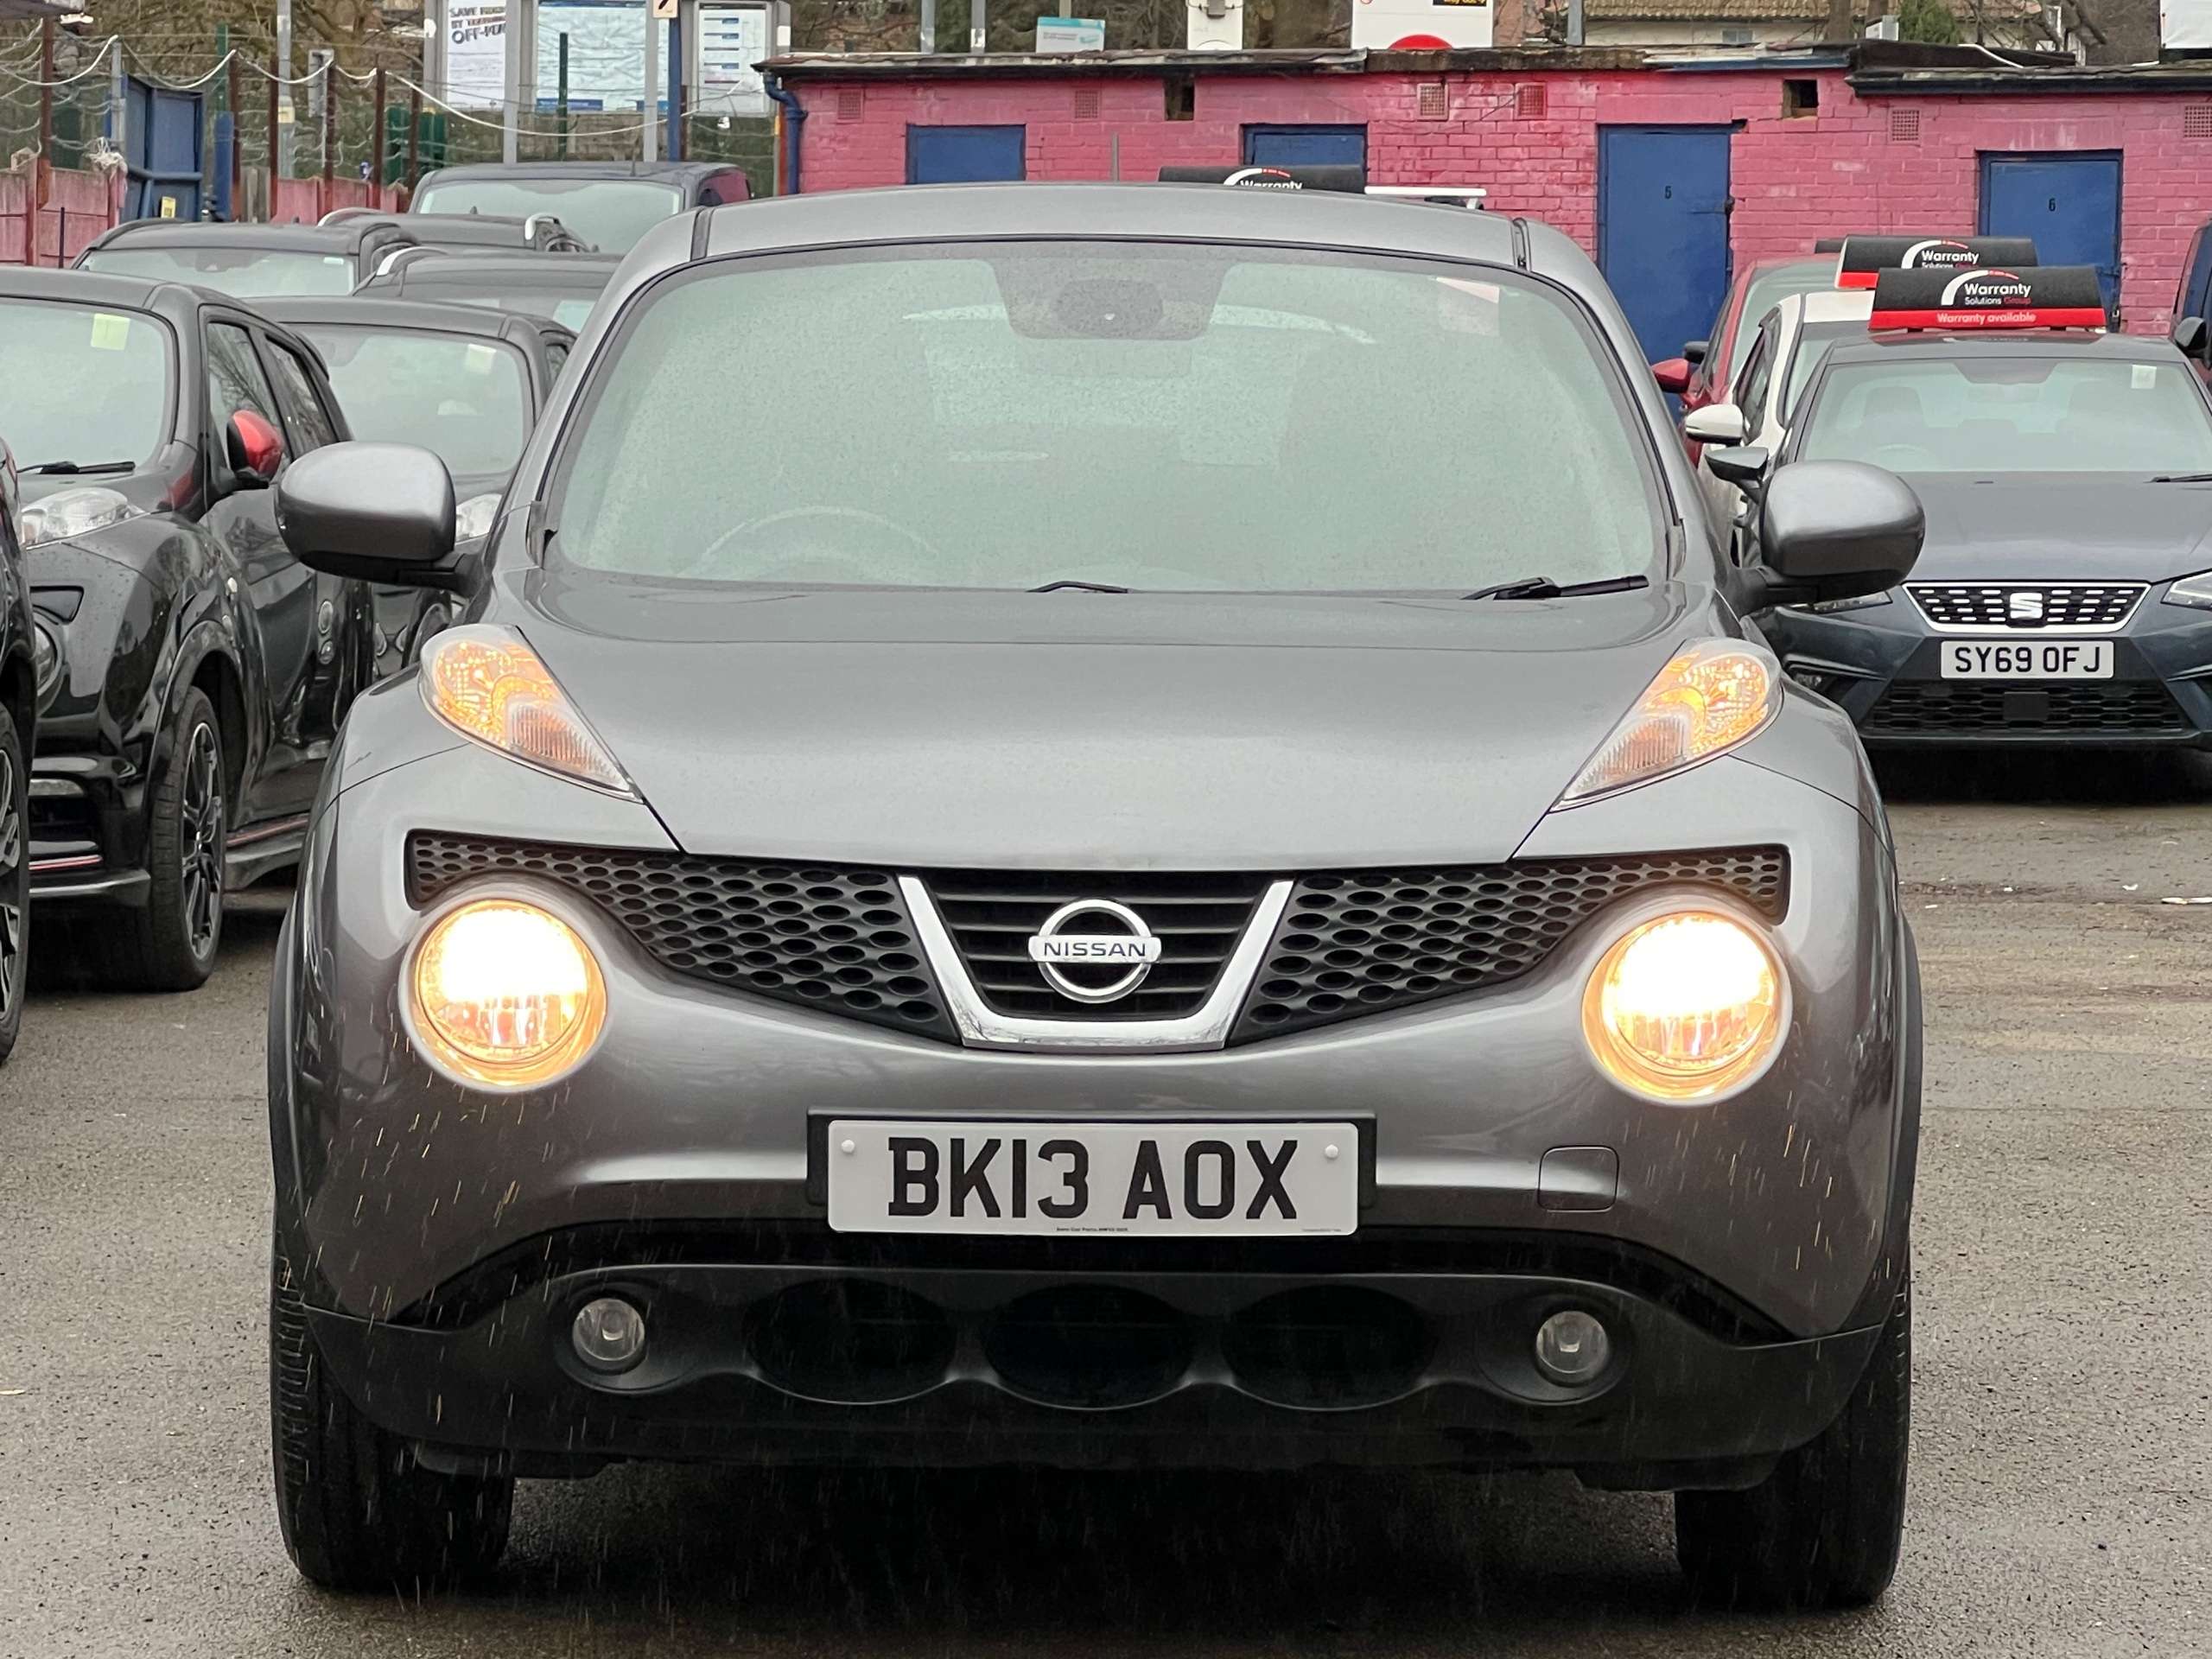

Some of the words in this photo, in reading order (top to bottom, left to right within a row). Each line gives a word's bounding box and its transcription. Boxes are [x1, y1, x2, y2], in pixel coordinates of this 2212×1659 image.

[1665, 185, 1672, 200] 5
[2049, 198, 2056, 212] 6
[1922, 250, 1979, 264] Warranty
[1964, 283, 2031, 298] Warranty
[1964, 296, 2002, 305] Solutions
[1936, 314, 1986, 326] Warranty
[1987, 312, 2037, 323] available
[1955, 646, 2032, 673] SY69
[2043, 646, 2101, 673] OFJ
[1044, 942, 1146, 957] NISSAN
[887, 1136, 1090, 1219] BK13
[1122, 1139, 1299, 1220] AOX
